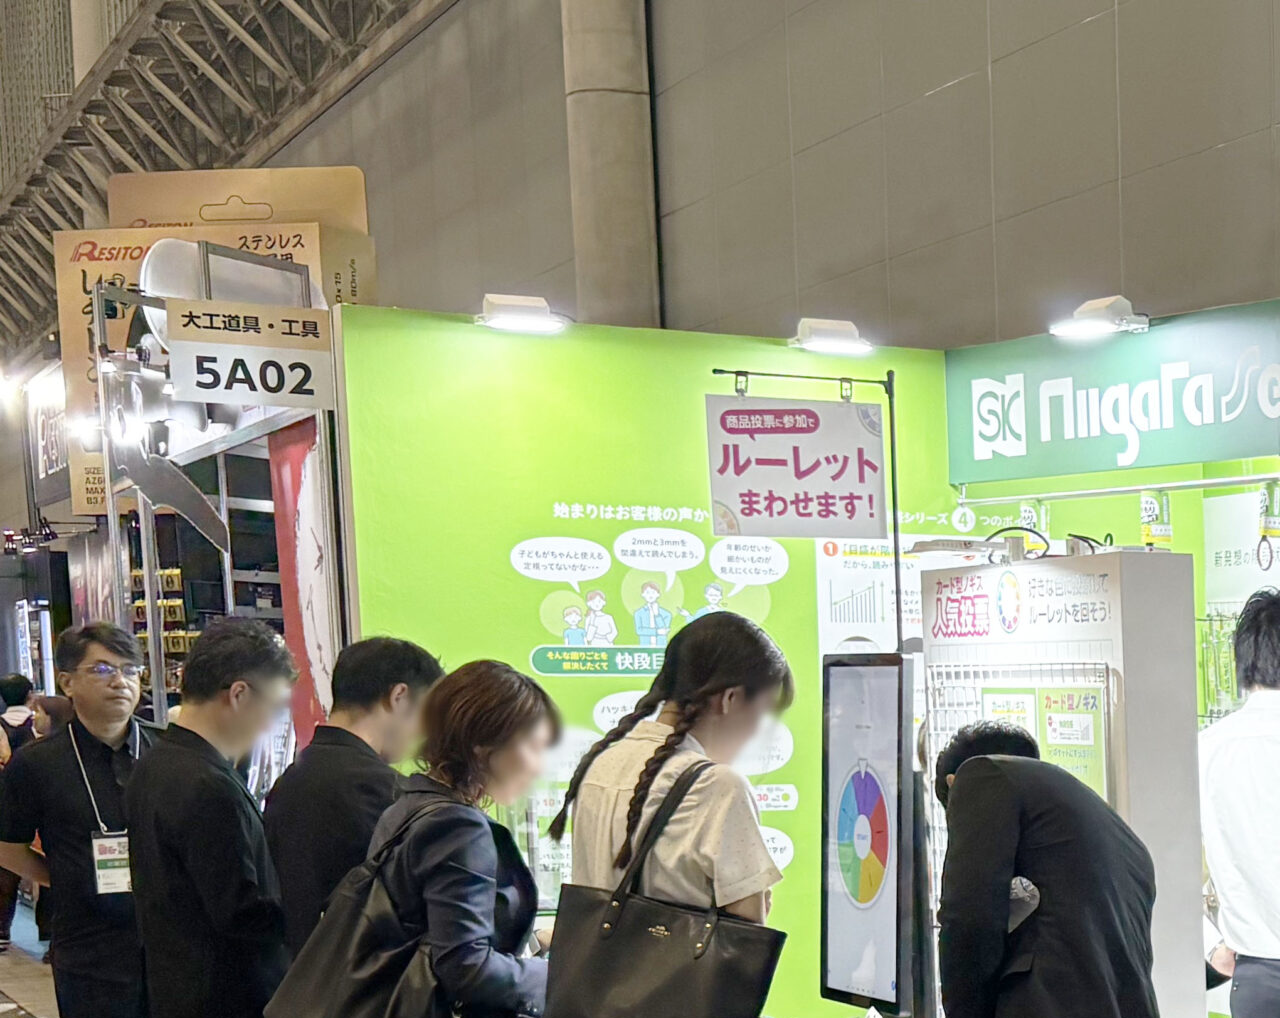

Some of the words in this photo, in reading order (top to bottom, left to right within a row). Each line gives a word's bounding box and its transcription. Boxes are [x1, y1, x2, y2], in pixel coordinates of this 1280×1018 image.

[181, 311, 320, 338] 大工道具・工具
[195, 356, 315, 396] 5A02
[725, 415, 815, 429] 商品投票に参加で
[717, 444, 879, 484] ルーレット
[739, 489, 875, 520] まわせます！
[932, 594, 990, 638] 人気投票
